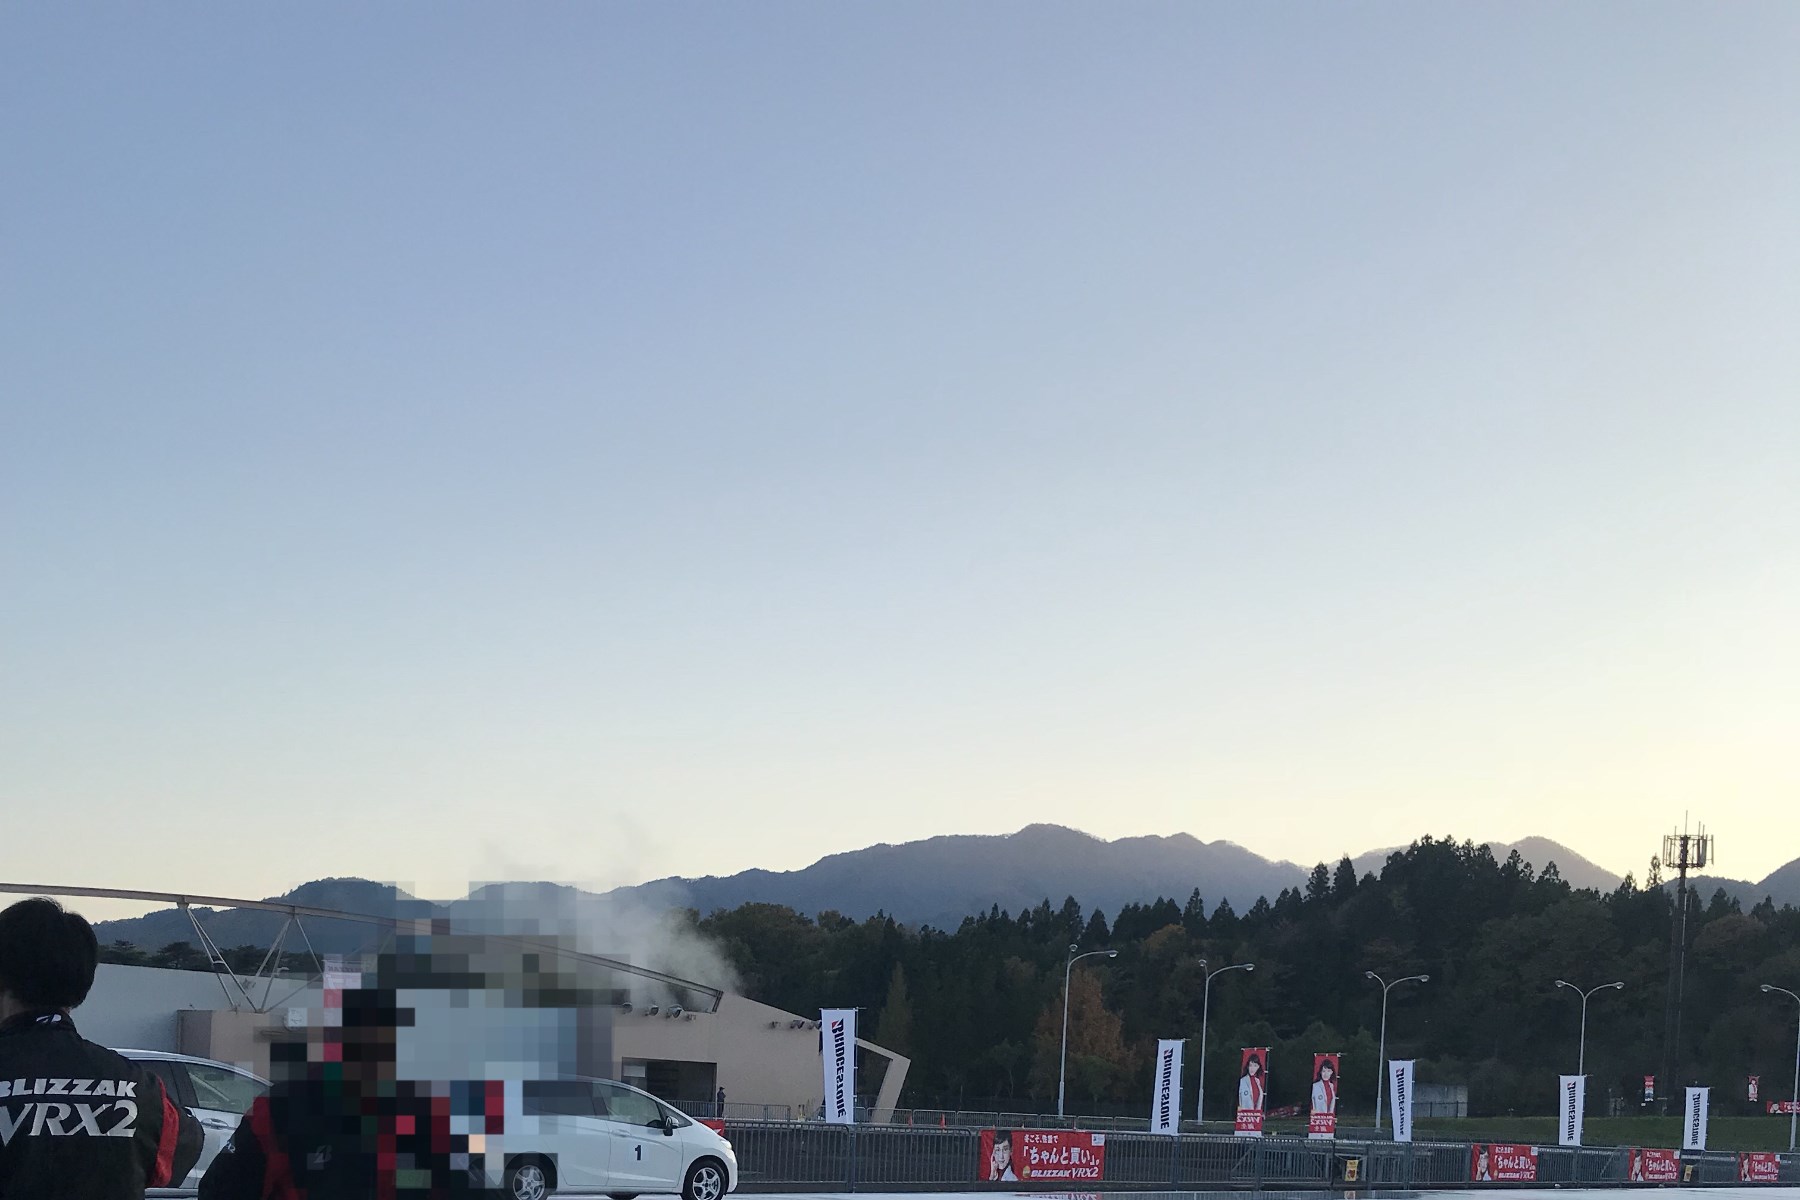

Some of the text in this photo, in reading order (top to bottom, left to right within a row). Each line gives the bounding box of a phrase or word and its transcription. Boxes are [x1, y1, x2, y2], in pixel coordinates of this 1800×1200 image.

[0, 1078, 138, 1098] BLIZZAK
[0, 1100, 138, 1147] VRX2
[634, 1144, 642, 1161] 1
[1030, 1166, 1099, 1179] BLIZZAK VRX2
